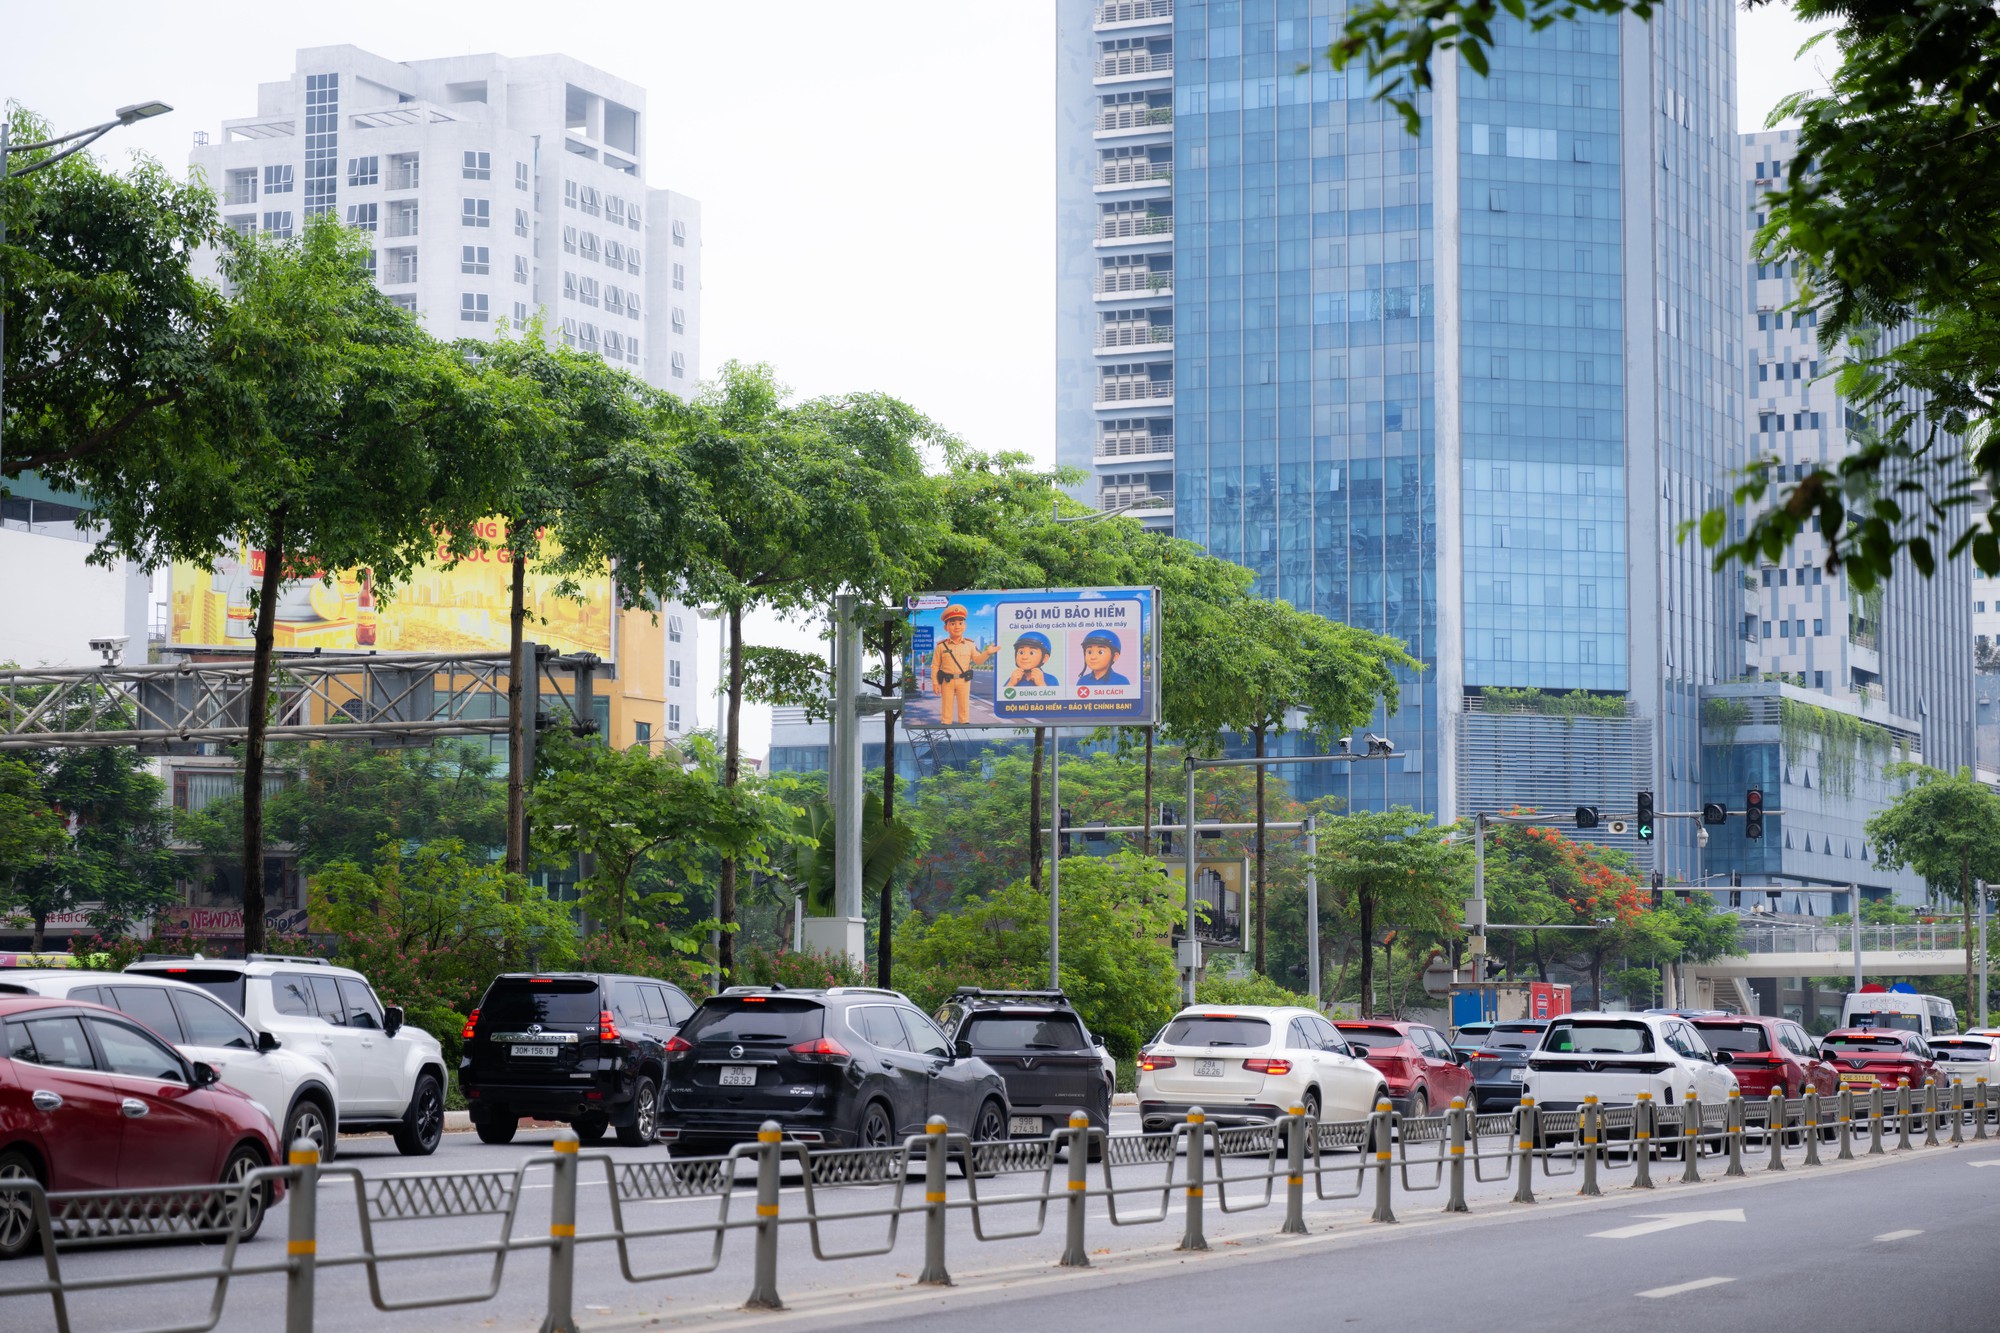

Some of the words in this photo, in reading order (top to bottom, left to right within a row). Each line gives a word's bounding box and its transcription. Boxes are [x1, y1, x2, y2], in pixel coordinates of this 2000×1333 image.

[1015, 606, 1037, 622] ĐỘI
[1041, 606, 1060, 619] MŨ
[1064, 604, 1090, 619] BẢO
[1094, 603, 1126, 618] HIỂM
[1020, 622, 1034, 630] quai
[1114, 620, 1128, 628] máy
[1019, 688, 1037, 697] ĐÚNG
[1038, 687, 1056, 697] CÁCH
[1094, 688, 1105, 696] SAI
[1106, 687, 1124, 696] CÁCH
[1005, 703, 1018, 713] ĐỘI
[1018, 703, 1029, 712] MŨ
[1030, 702, 1045, 711] BẢO
[1045, 701, 1062, 711] HIỂM
[1068, 702, 1082, 711] BẢO
[1083, 702, 1092, 712] VỆ
[1093, 701, 1115, 711] CHÍNH
[514, 1046, 554, 1056] 30M-156.16
[1203, 1060, 1216, 1068] 29A
[731, 1067, 746, 1076] 30L
[1197, 1067, 1220, 1076] 462.26
[723, 1075, 752, 1085] 628.92
[1018, 1117, 1034, 1125] 99B
[1013, 1125, 1039, 1133] 274.91
